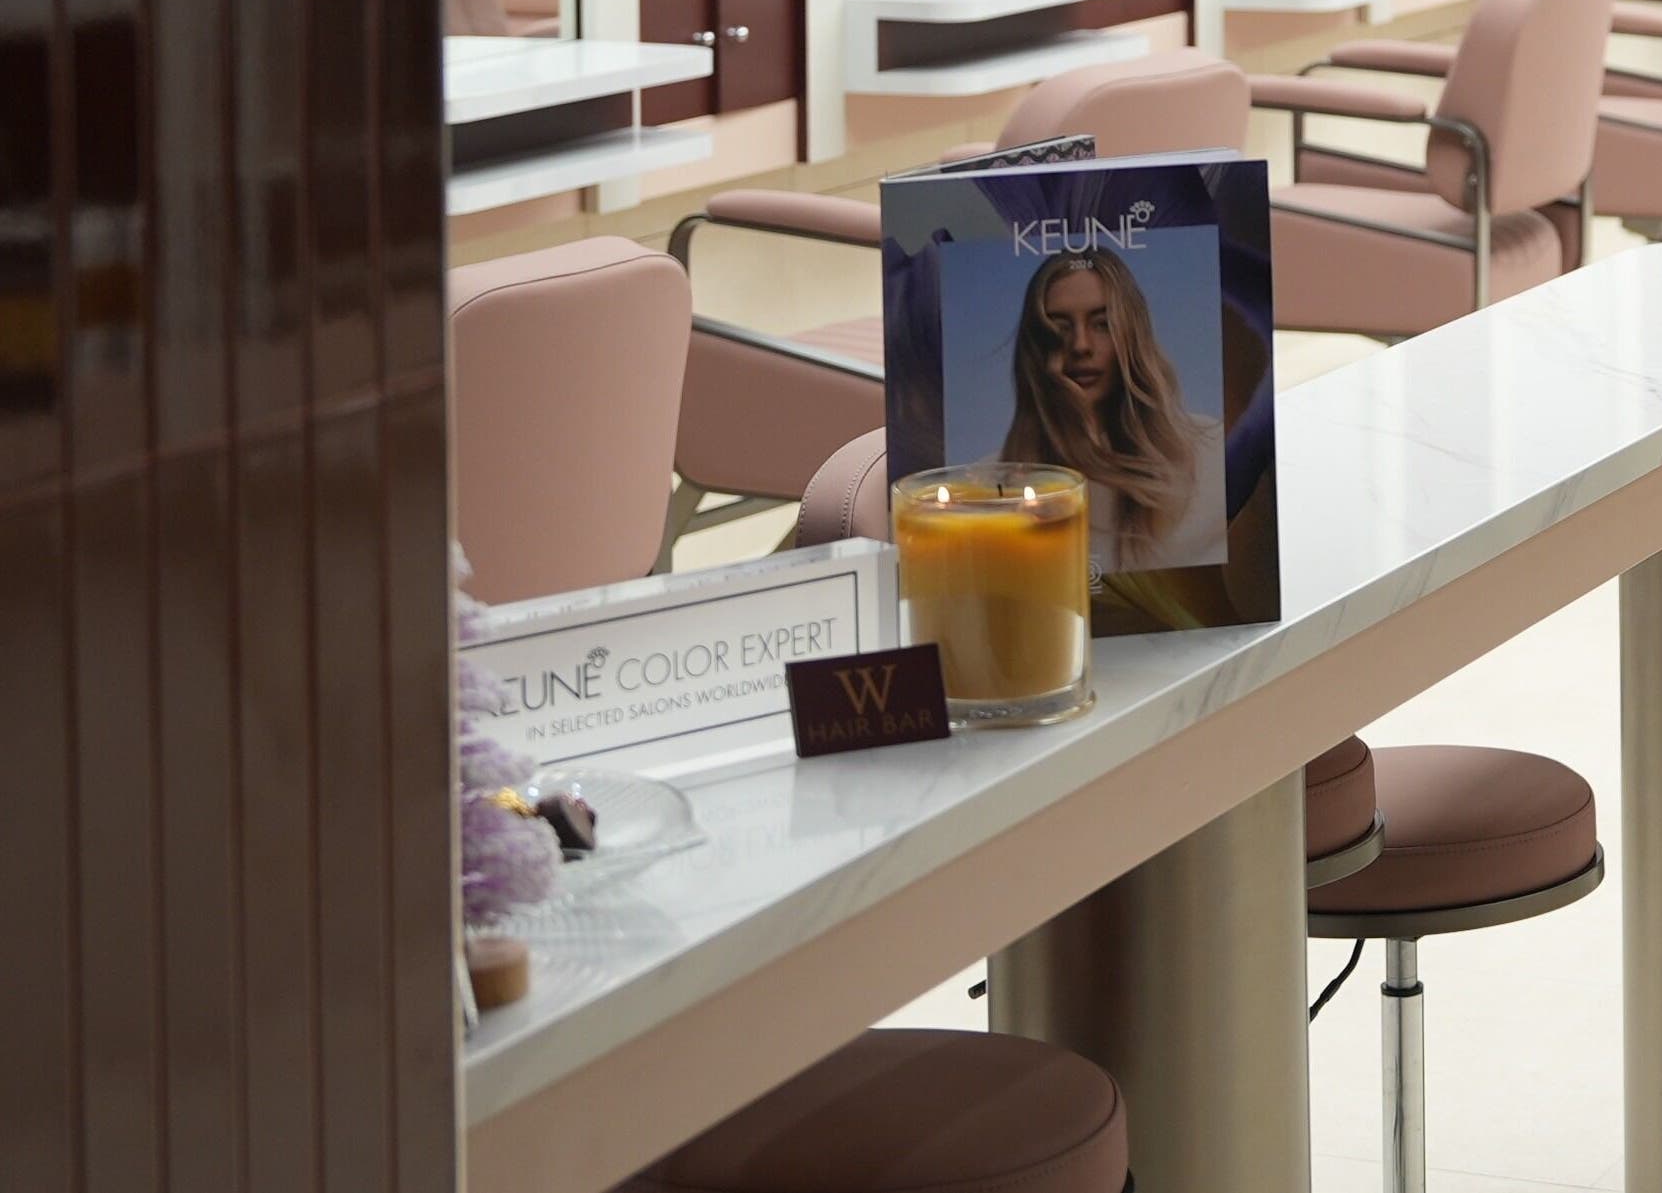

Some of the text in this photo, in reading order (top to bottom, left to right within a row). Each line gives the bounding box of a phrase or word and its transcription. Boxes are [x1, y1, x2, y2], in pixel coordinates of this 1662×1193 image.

[1013, 211, 1148, 257] KEUNE
[615, 639, 730, 691] COLOR
[740, 617, 838, 668] EXPERT
[525, 671, 787, 742] IN SELECTED SALONS WORLDWID
[834, 663, 898, 717] W
[807, 707, 936, 743] HAIR BAR
